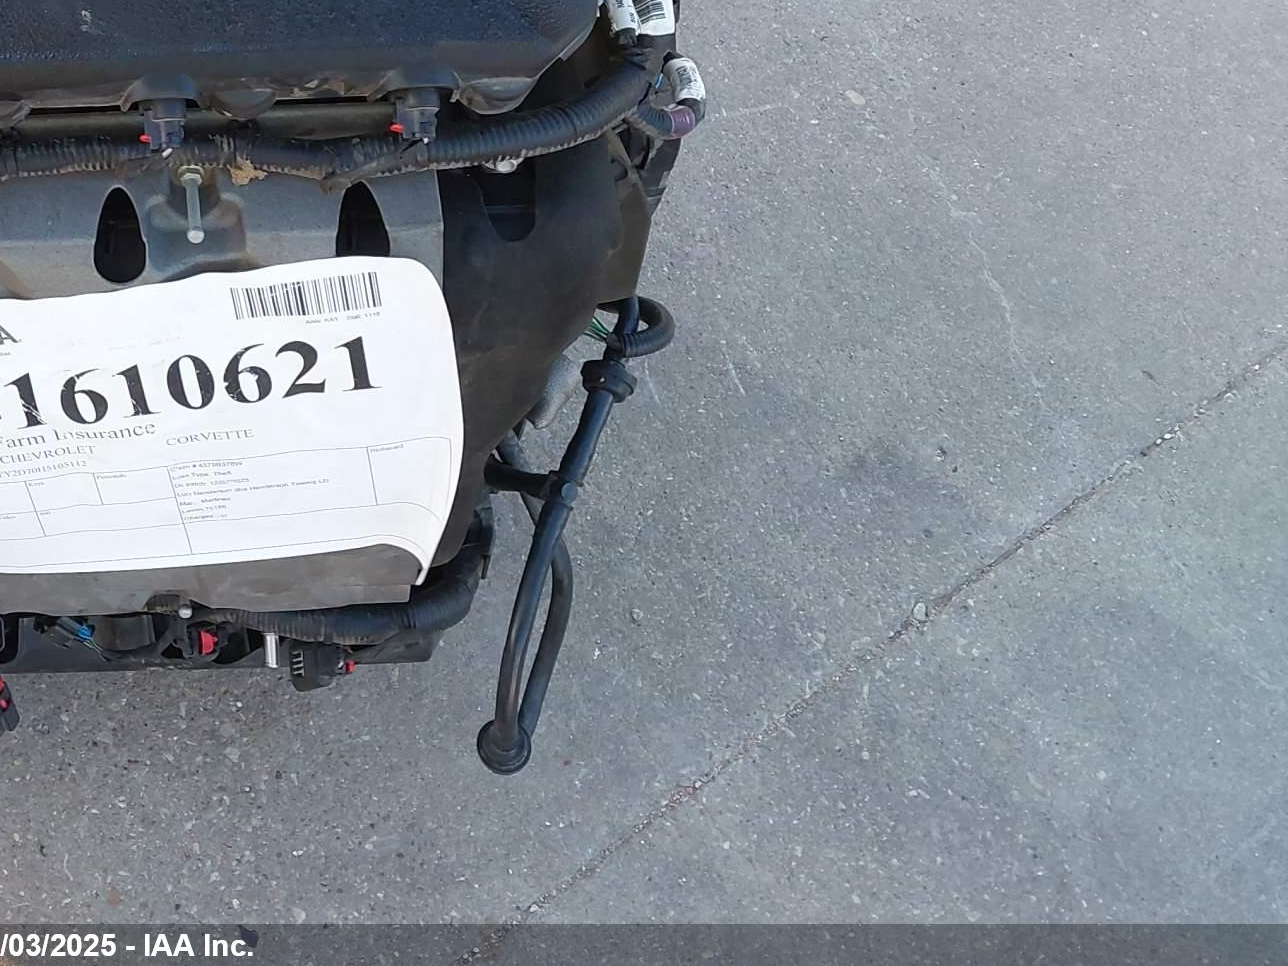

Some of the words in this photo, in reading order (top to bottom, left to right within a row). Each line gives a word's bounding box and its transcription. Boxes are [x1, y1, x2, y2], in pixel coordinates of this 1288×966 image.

[53, 422, 157, 442] Insurance
[0, 445, 96, 465] CHEVROLET
[166, 429, 254, 447] CORVETTE
